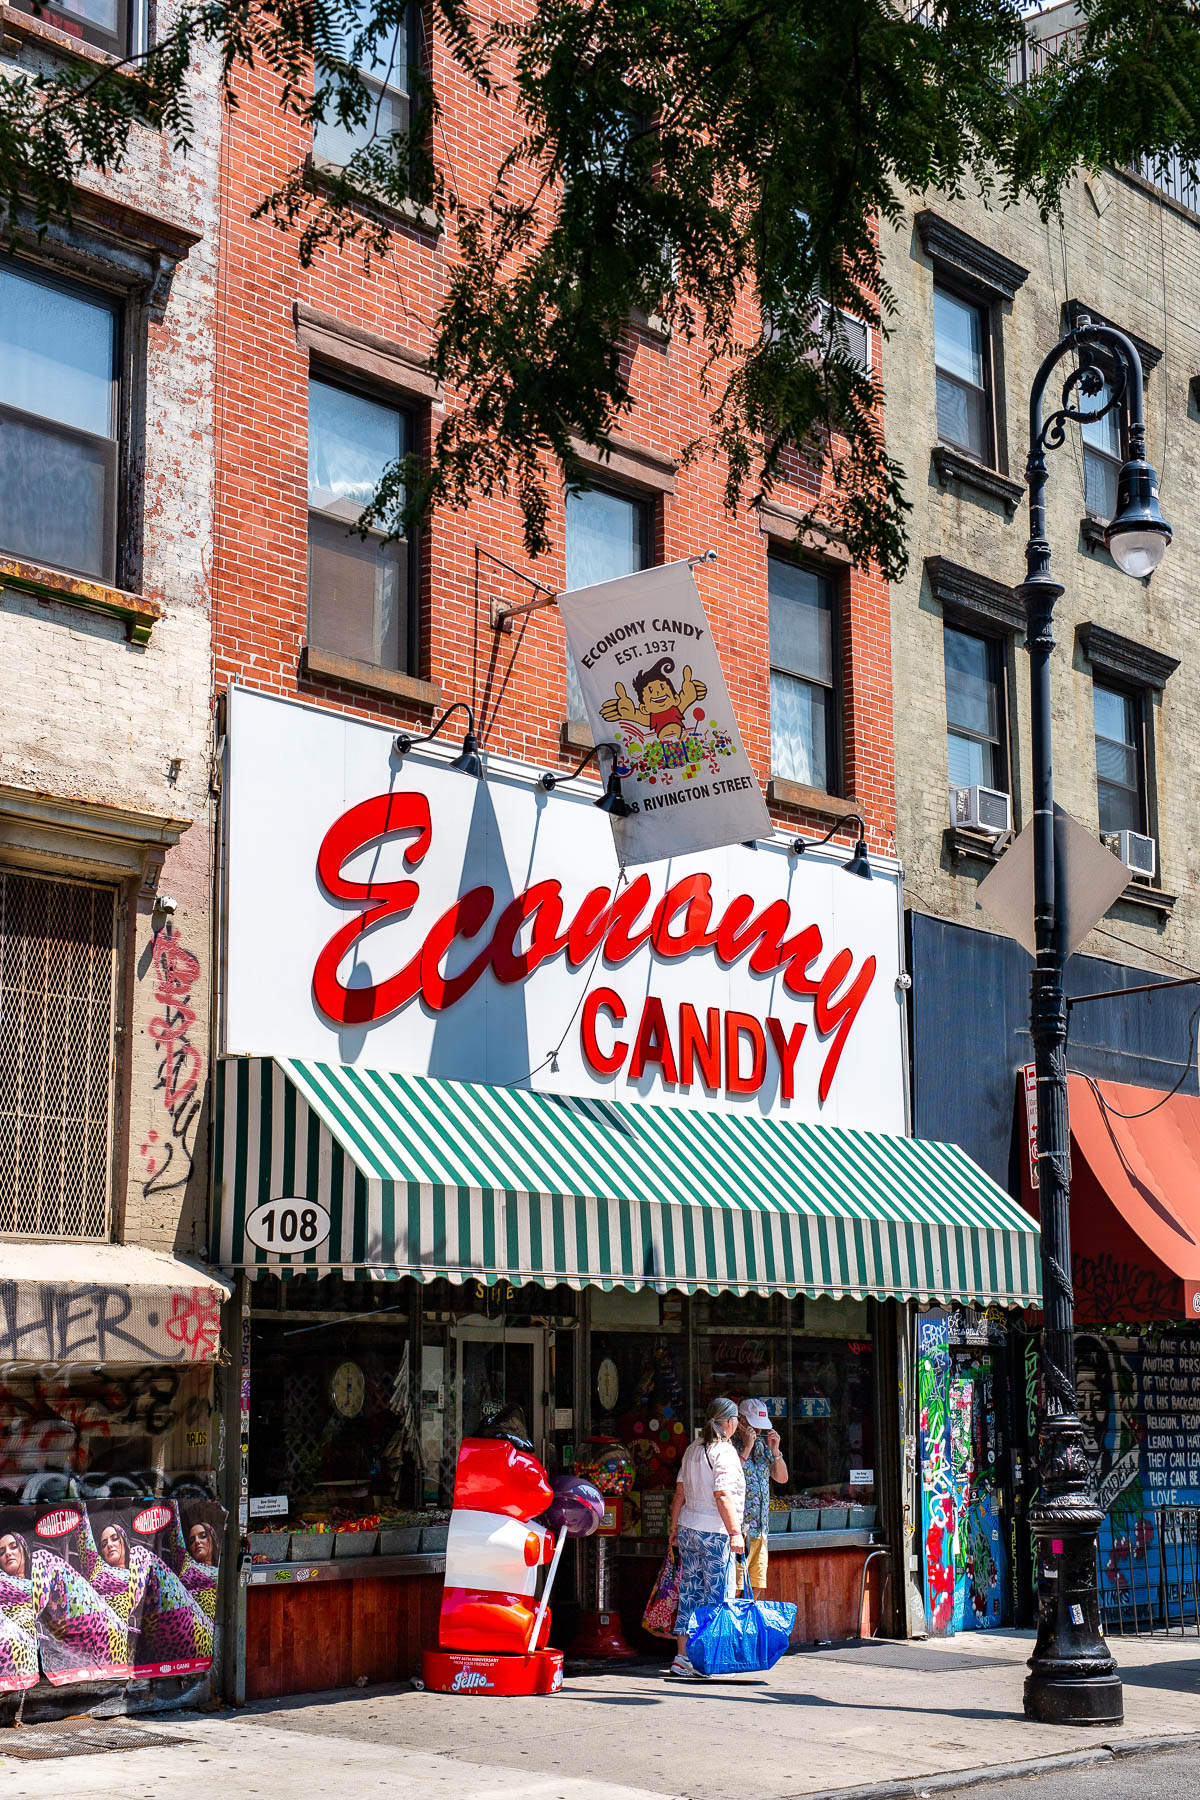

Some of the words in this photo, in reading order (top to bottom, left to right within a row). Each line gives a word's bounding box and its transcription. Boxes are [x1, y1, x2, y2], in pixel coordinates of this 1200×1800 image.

[581, 619, 646, 670] ECONOMY
[652, 618, 705, 641] CANDY
[614, 645, 643, 666] EST.
[644, 639, 677, 657] 1937
[643, 785, 710, 812] RIVINGTON
[713, 776, 754, 797] STREET
[312, 791, 877, 1102] Economy
[581, 986, 808, 1099] CANDY
[260, 1208, 318, 1245] 108
[1142, 1356, 1175, 1373] ANOTHER
[1143, 1375, 1152, 1391] OF
[1154, 1375, 1169, 1391] THE
[1170, 1376, 1189, 1391] COLOR
[1144, 1394, 1155, 1410] OR
[1156, 1394, 1168, 1410] HIS
[1146, 1414, 1179, 1429] RELIGION.
[1147, 1435, 1173, 1449] LEARN
[1176, 1434, 1185, 1448] TO
[1147, 1452, 1166, 1468] THEY
[1169, 1452, 1185, 1467] CAN
[1148, 1471, 1168, 1486] THEY
[1170, 1470, 1187, 1486] CAN
[1189, 1470, 1199, 1486] BE
[451, 1671, 487, 1691] Jellio
